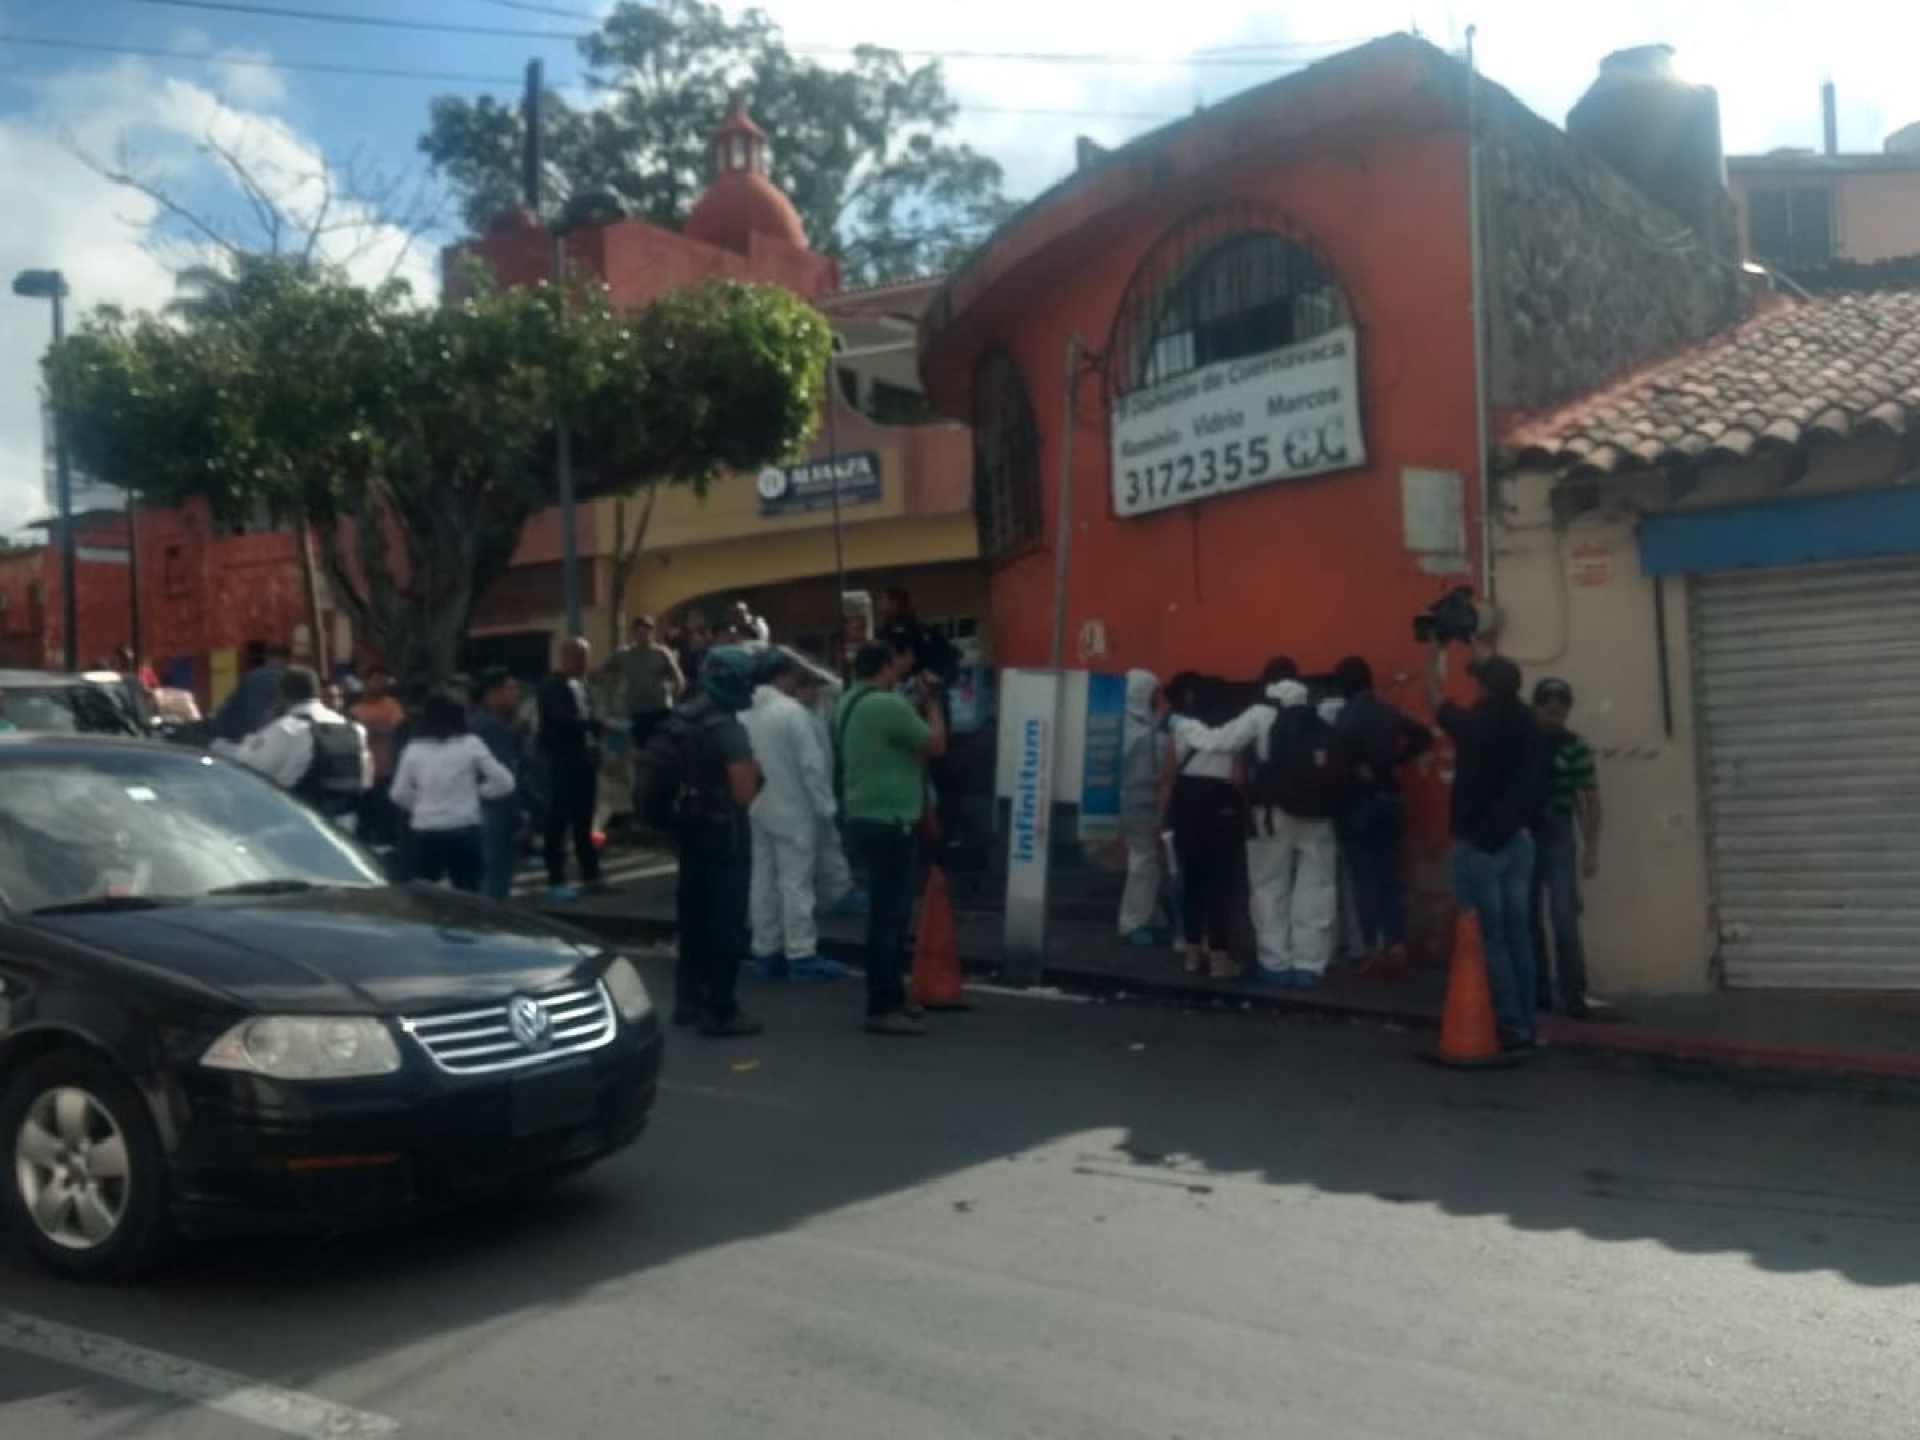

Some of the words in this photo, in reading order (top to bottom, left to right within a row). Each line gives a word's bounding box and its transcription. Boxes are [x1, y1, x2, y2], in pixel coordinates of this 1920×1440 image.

[1227, 341, 1345, 383] Cuernavaca
[1191, 408, 1246, 438] Vidrio
[1266, 385, 1341, 416] Marcos
[1125, 436, 1270, 505] 3172355
[1013, 719, 1040, 864] infinitum
